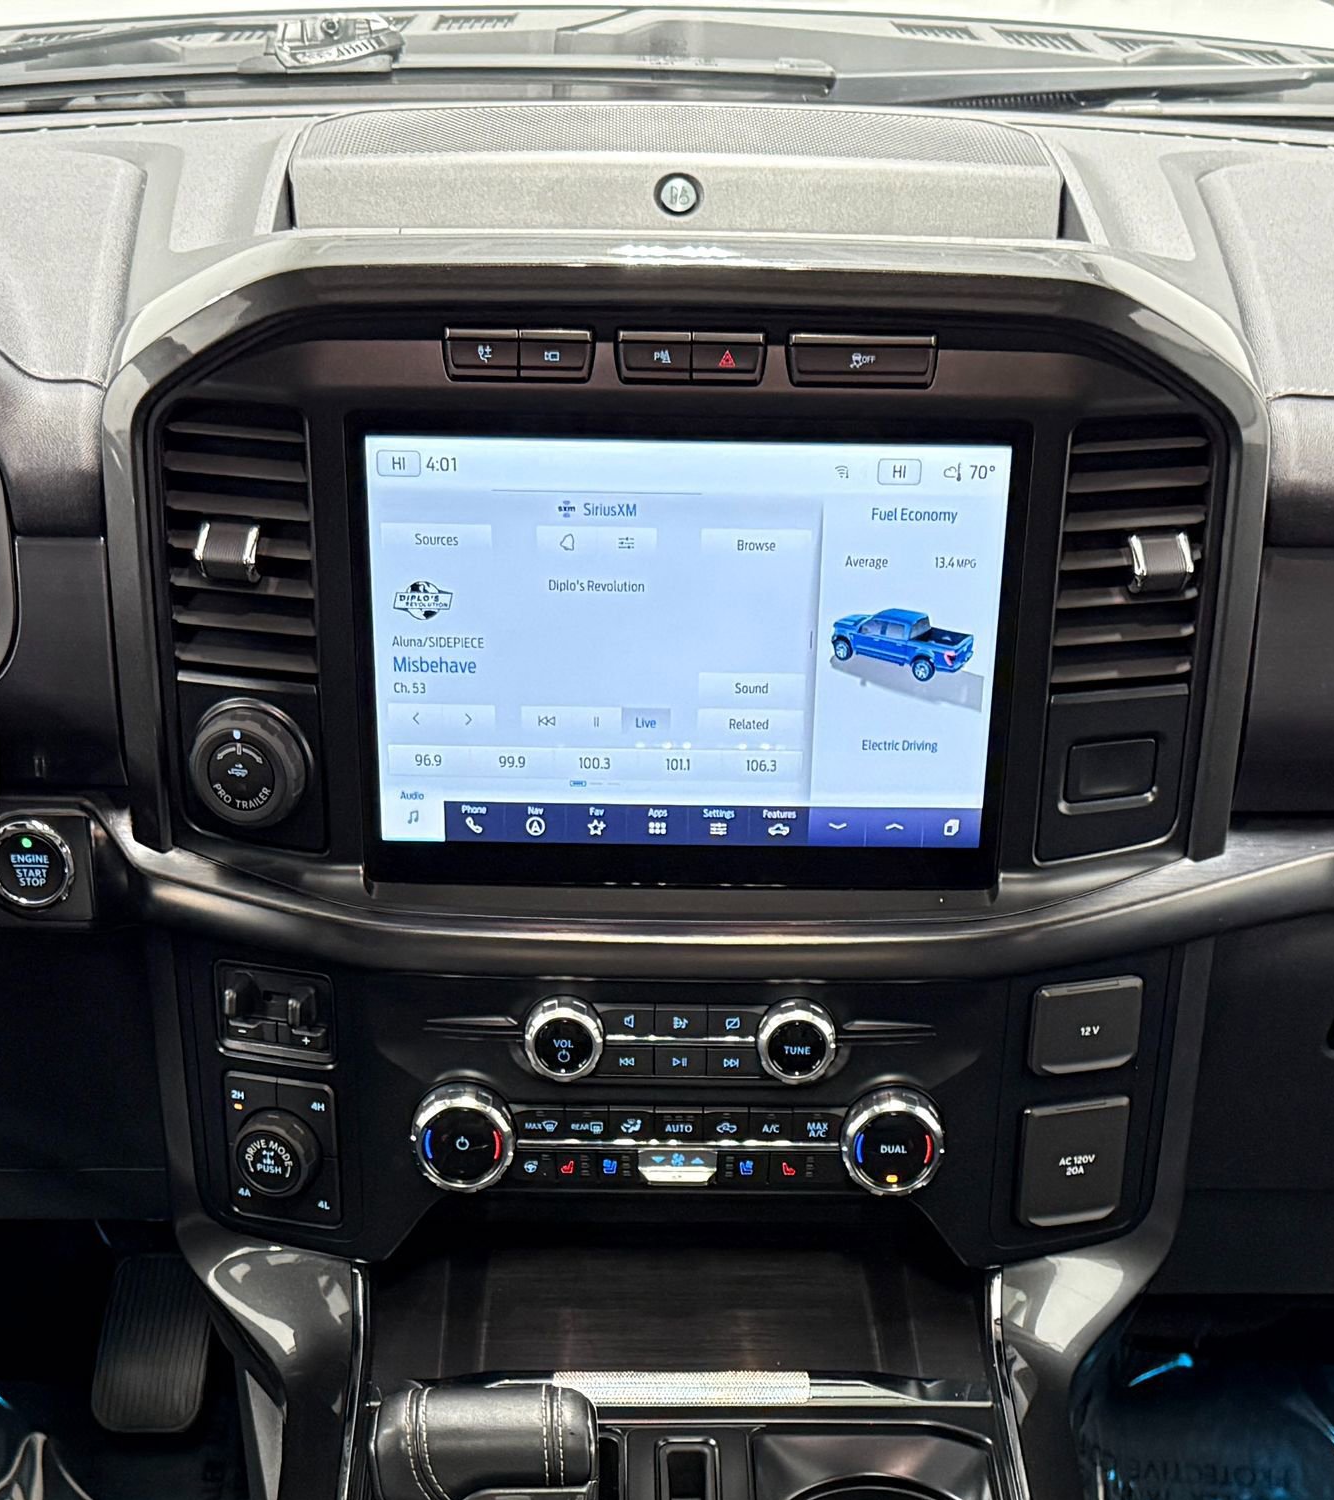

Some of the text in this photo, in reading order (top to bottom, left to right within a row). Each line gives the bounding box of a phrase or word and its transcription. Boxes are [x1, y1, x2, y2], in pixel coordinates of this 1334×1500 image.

[862, 355, 876, 364] OFF
[392, 457, 406, 471] HI
[426, 457, 457, 472] 4:01
[892, 465, 907, 479] HI
[969, 465, 996, 480] 70°
[583, 502, 637, 517] SiriusXM
[871, 507, 958, 524] Fuel Economy
[415, 533, 459, 546] Sources
[737, 539, 776, 552] Browse
[845, 555, 889, 569] Average
[934, 556, 977, 569] 13.4 MPG
[548, 579, 645, 593] Diplo's Revolution
[392, 636, 484, 649] Aluna/SIDEPIECE
[393, 656, 477, 674] Misbehave
[393, 682, 426, 694] Ch. 53
[734, 682, 769, 694] Sound
[635, 717, 656, 729] Live
[729, 719, 769, 730] Related
[862, 739, 938, 753] Electric Driving
[414, 754, 442, 767] 96.9
[499, 755, 526, 769] 99.9
[578, 756, 611, 770] 100.3
[666, 758, 691, 771] 101.1
[745, 759, 777, 773] 106.3
[213, 784, 271, 809] PRO TRAILER
[400, 790, 424, 800] Audio
[461, 805, 487, 814] Phone
[528, 806, 544, 815] Nav
[589, 807, 605, 817] Fav
[648, 808, 668, 818] Apps
[703, 808, 735, 820] Settings
[762, 809, 796, 820] Features
[10, 854, 50, 865] ENGINE
[16, 868, 47, 878] START
[18, 876, 47, 887] STOP
[1080, 1026, 1100, 1036] 12 V
[553, 1040, 574, 1049] VOL
[784, 1046, 811, 1056] TUNE
[231, 1090, 244, 1100] 2H
[310, 1102, 325, 1112] 4H
[665, 1124, 693, 1133] AUTO
[762, 1124, 780, 1134] A/C
[807, 1122, 828, 1131] MAX
[809, 1130, 826, 1138] A/C
[245, 1139, 293, 1167] DRIVE MODE
[880, 1145, 907, 1154] DUAL
[1059, 1154, 1095, 1167] AC 120V
[256, 1163, 282, 1175] PUSH
[1066, 1166, 1084, 1176] 20A
[238, 1187, 251, 1198] 4A
[317, 1201, 330, 1211] 4L
